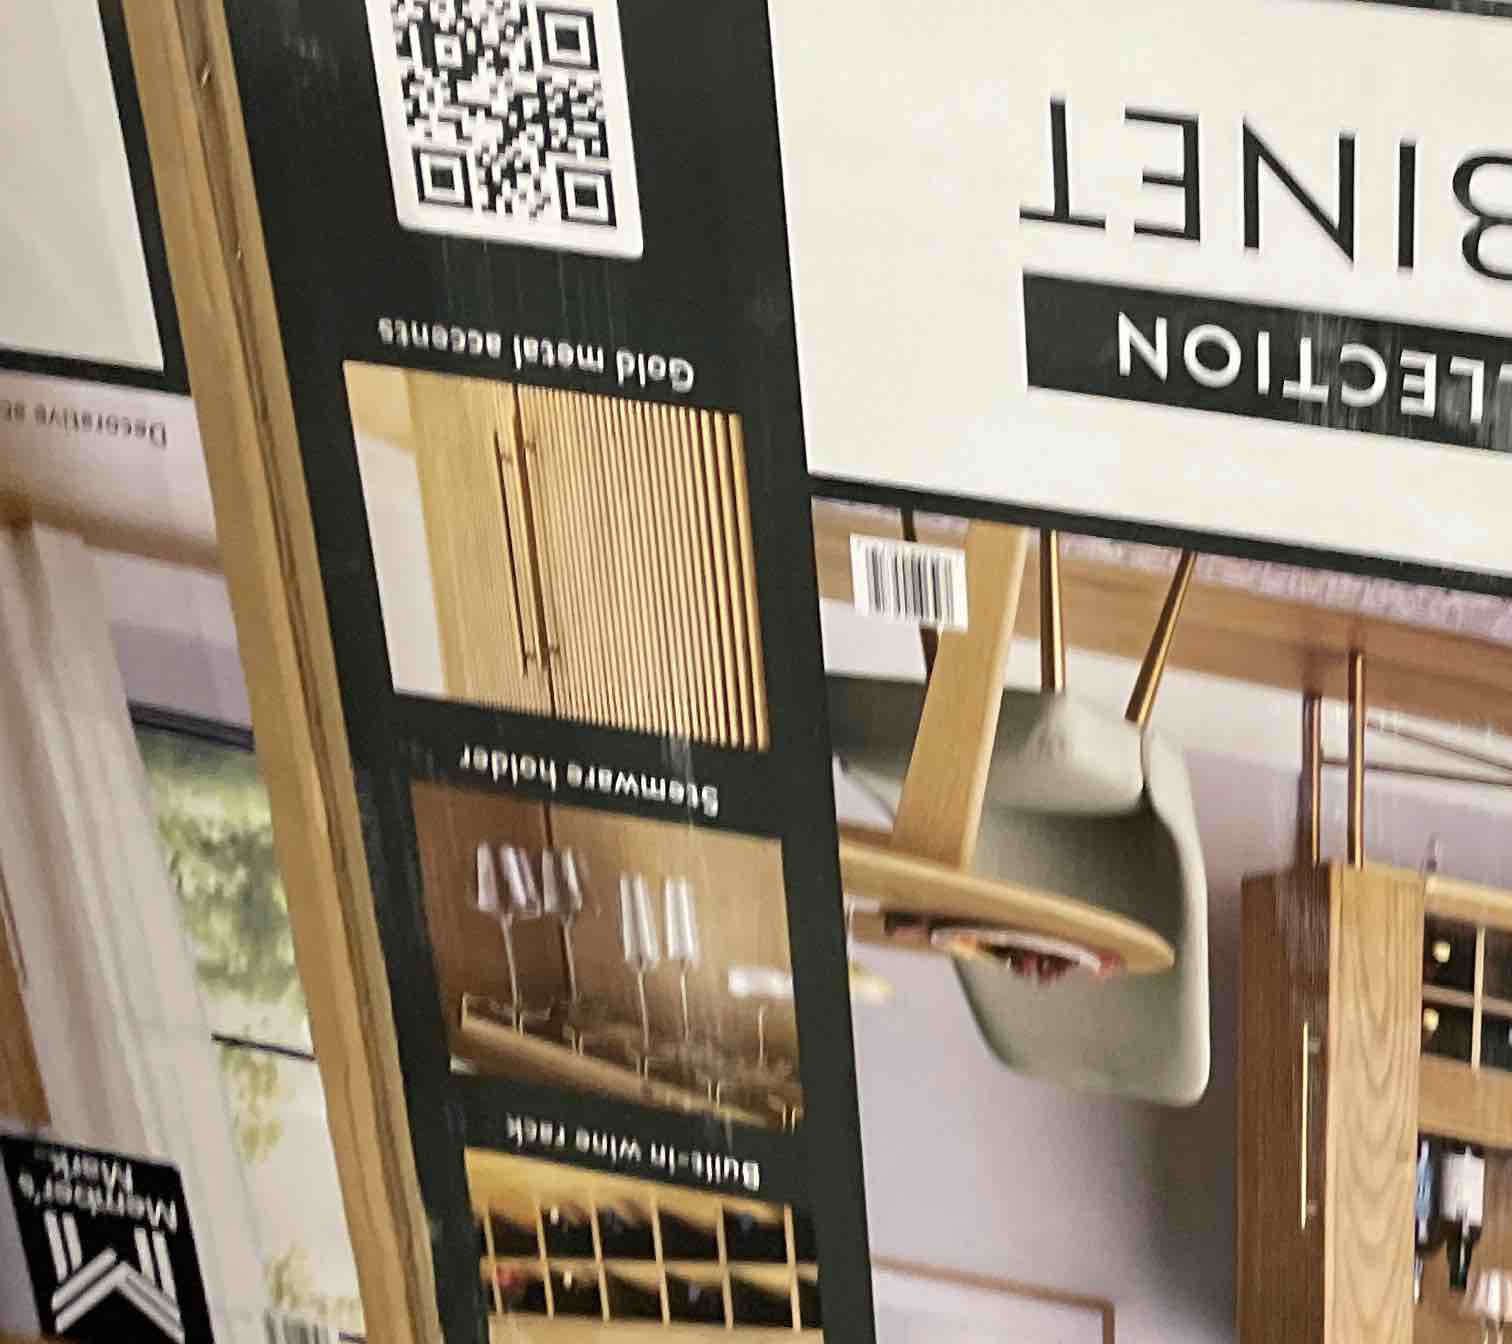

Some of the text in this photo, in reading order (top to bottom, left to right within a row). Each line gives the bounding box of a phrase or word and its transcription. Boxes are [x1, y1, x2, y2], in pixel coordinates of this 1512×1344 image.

[377, 316, 695, 393] Gold metal accents
[458, 744, 719, 817] Stemware holder
[506, 1113, 760, 1191] Built-in wine rack
